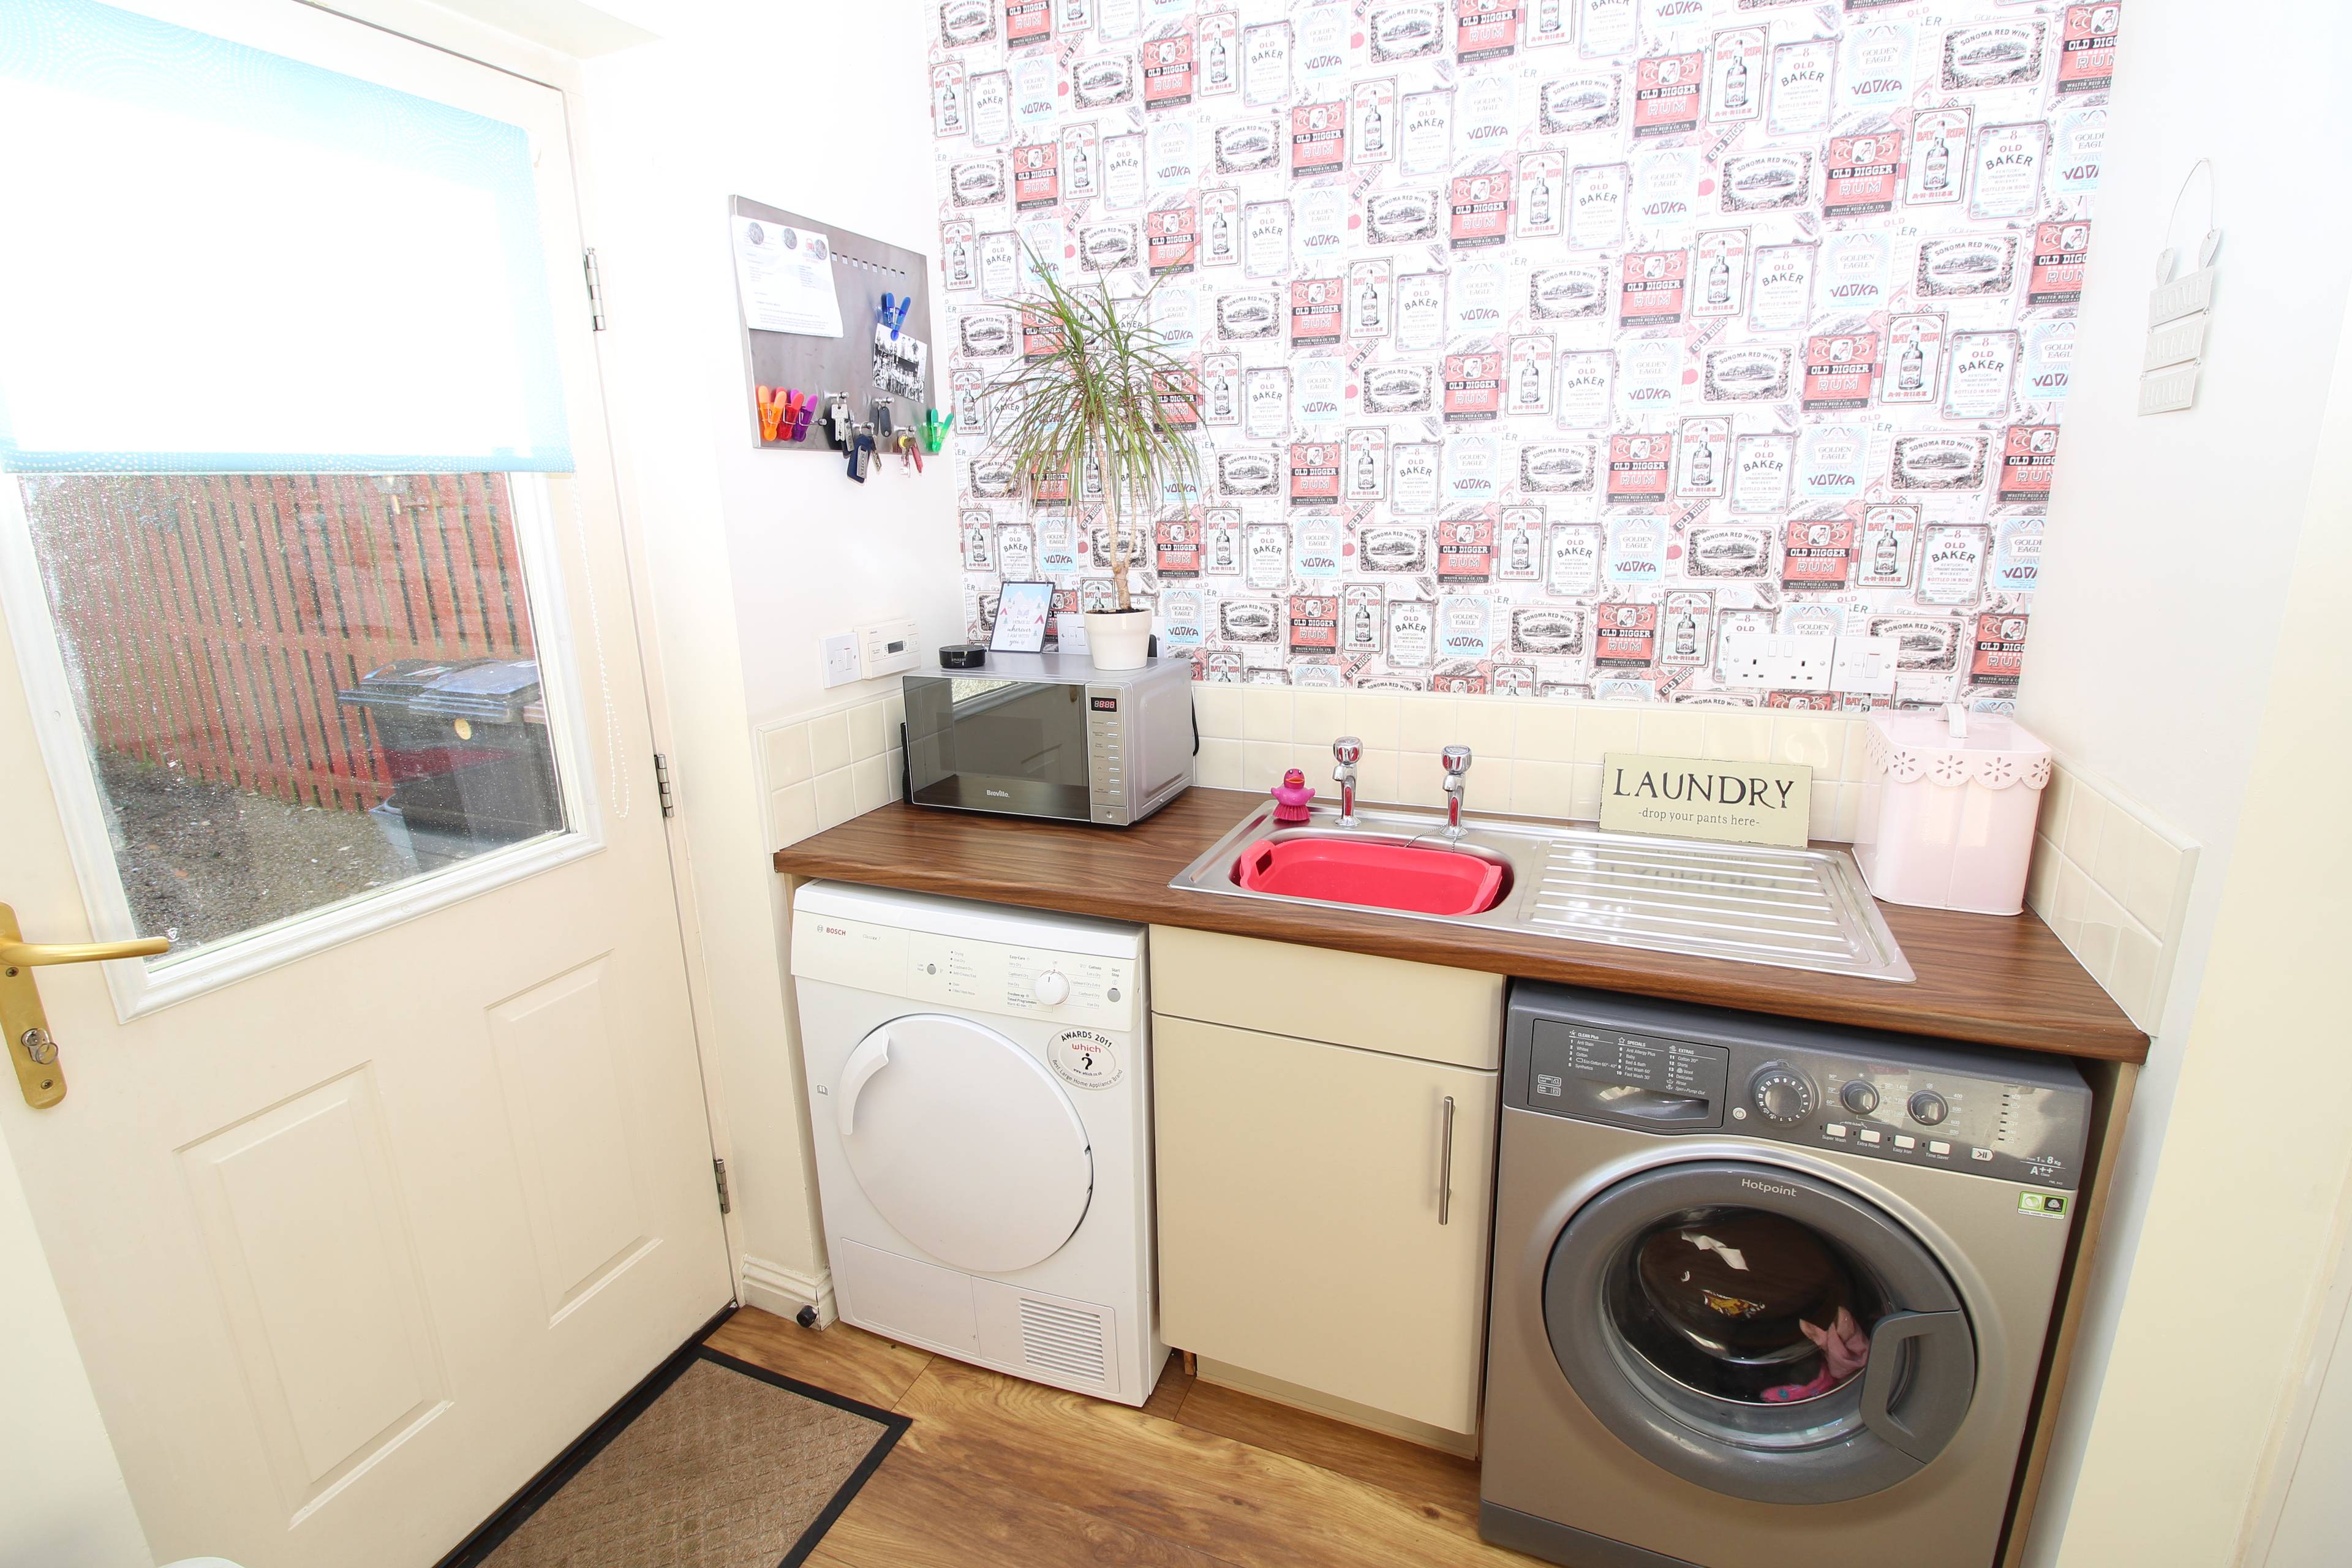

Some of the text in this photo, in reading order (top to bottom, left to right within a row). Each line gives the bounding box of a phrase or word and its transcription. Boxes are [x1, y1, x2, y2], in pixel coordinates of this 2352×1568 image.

[1961, 30, 1992, 46] SONOMA
[2011, 30, 2030, 39] WINE
[1716, 47, 1762, 60] BAY RUM
[1148, 64, 1189, 77] OLD DIGGER
[1155, 79, 1182, 91] RUM
[1781, 71, 1825, 87] BAKER
[1640, 86, 1697, 100] OLD DIGGER
[978, 96, 1004, 107] BAKER
[1648, 101, 1687, 116] RUM
[1404, 299, 1438, 310] BAKER
[2155, 279, 2201, 319] HOME
[1891, 333, 1939, 344] BAY RUM
[2148, 328, 2201, 363] SWEET
[1959, 361, 2004, 374] BAKER
[1466, 380, 1496, 389] DIGGER
[1455, 394, 1488, 404] RUM
[2144, 378, 2187, 409] HOME
[1300, 481, 1329, 489] RUM
[1703, 532, 1728, 541] SONOMA
[1744, 533, 1759, 543] WINE
[1166, 555, 1191, 564] RUM
[1931, 551, 1975, 564] BAKER
[1523, 612, 1546, 622] SONOMA
[1560, 614, 1574, 623] WINE
[1395, 623, 1427, 633] BAKER
[1607, 642, 1642, 652] RUM
[1613, 769, 1795, 809] LAUNDRY
[1669, 812, 1694, 823] your
[1697, 813, 1727, 824] pants
[826, 927, 846, 936] BOSCH
[1061, 1031, 1112, 1048] AWARDS 2011
[1072, 1043, 1101, 1053] which
[1060, 1069, 1072, 1080] Large
[1073, 1079, 1088, 1087] Home
[1089, 1079, 1113, 1088] Appliance
[1112, 1069, 1123, 1082] Brand
[2047, 1156, 2054, 1164] 8
[2030, 1166, 2054, 1175] A++
[1741, 1178, 1797, 1197] Hotpoint
